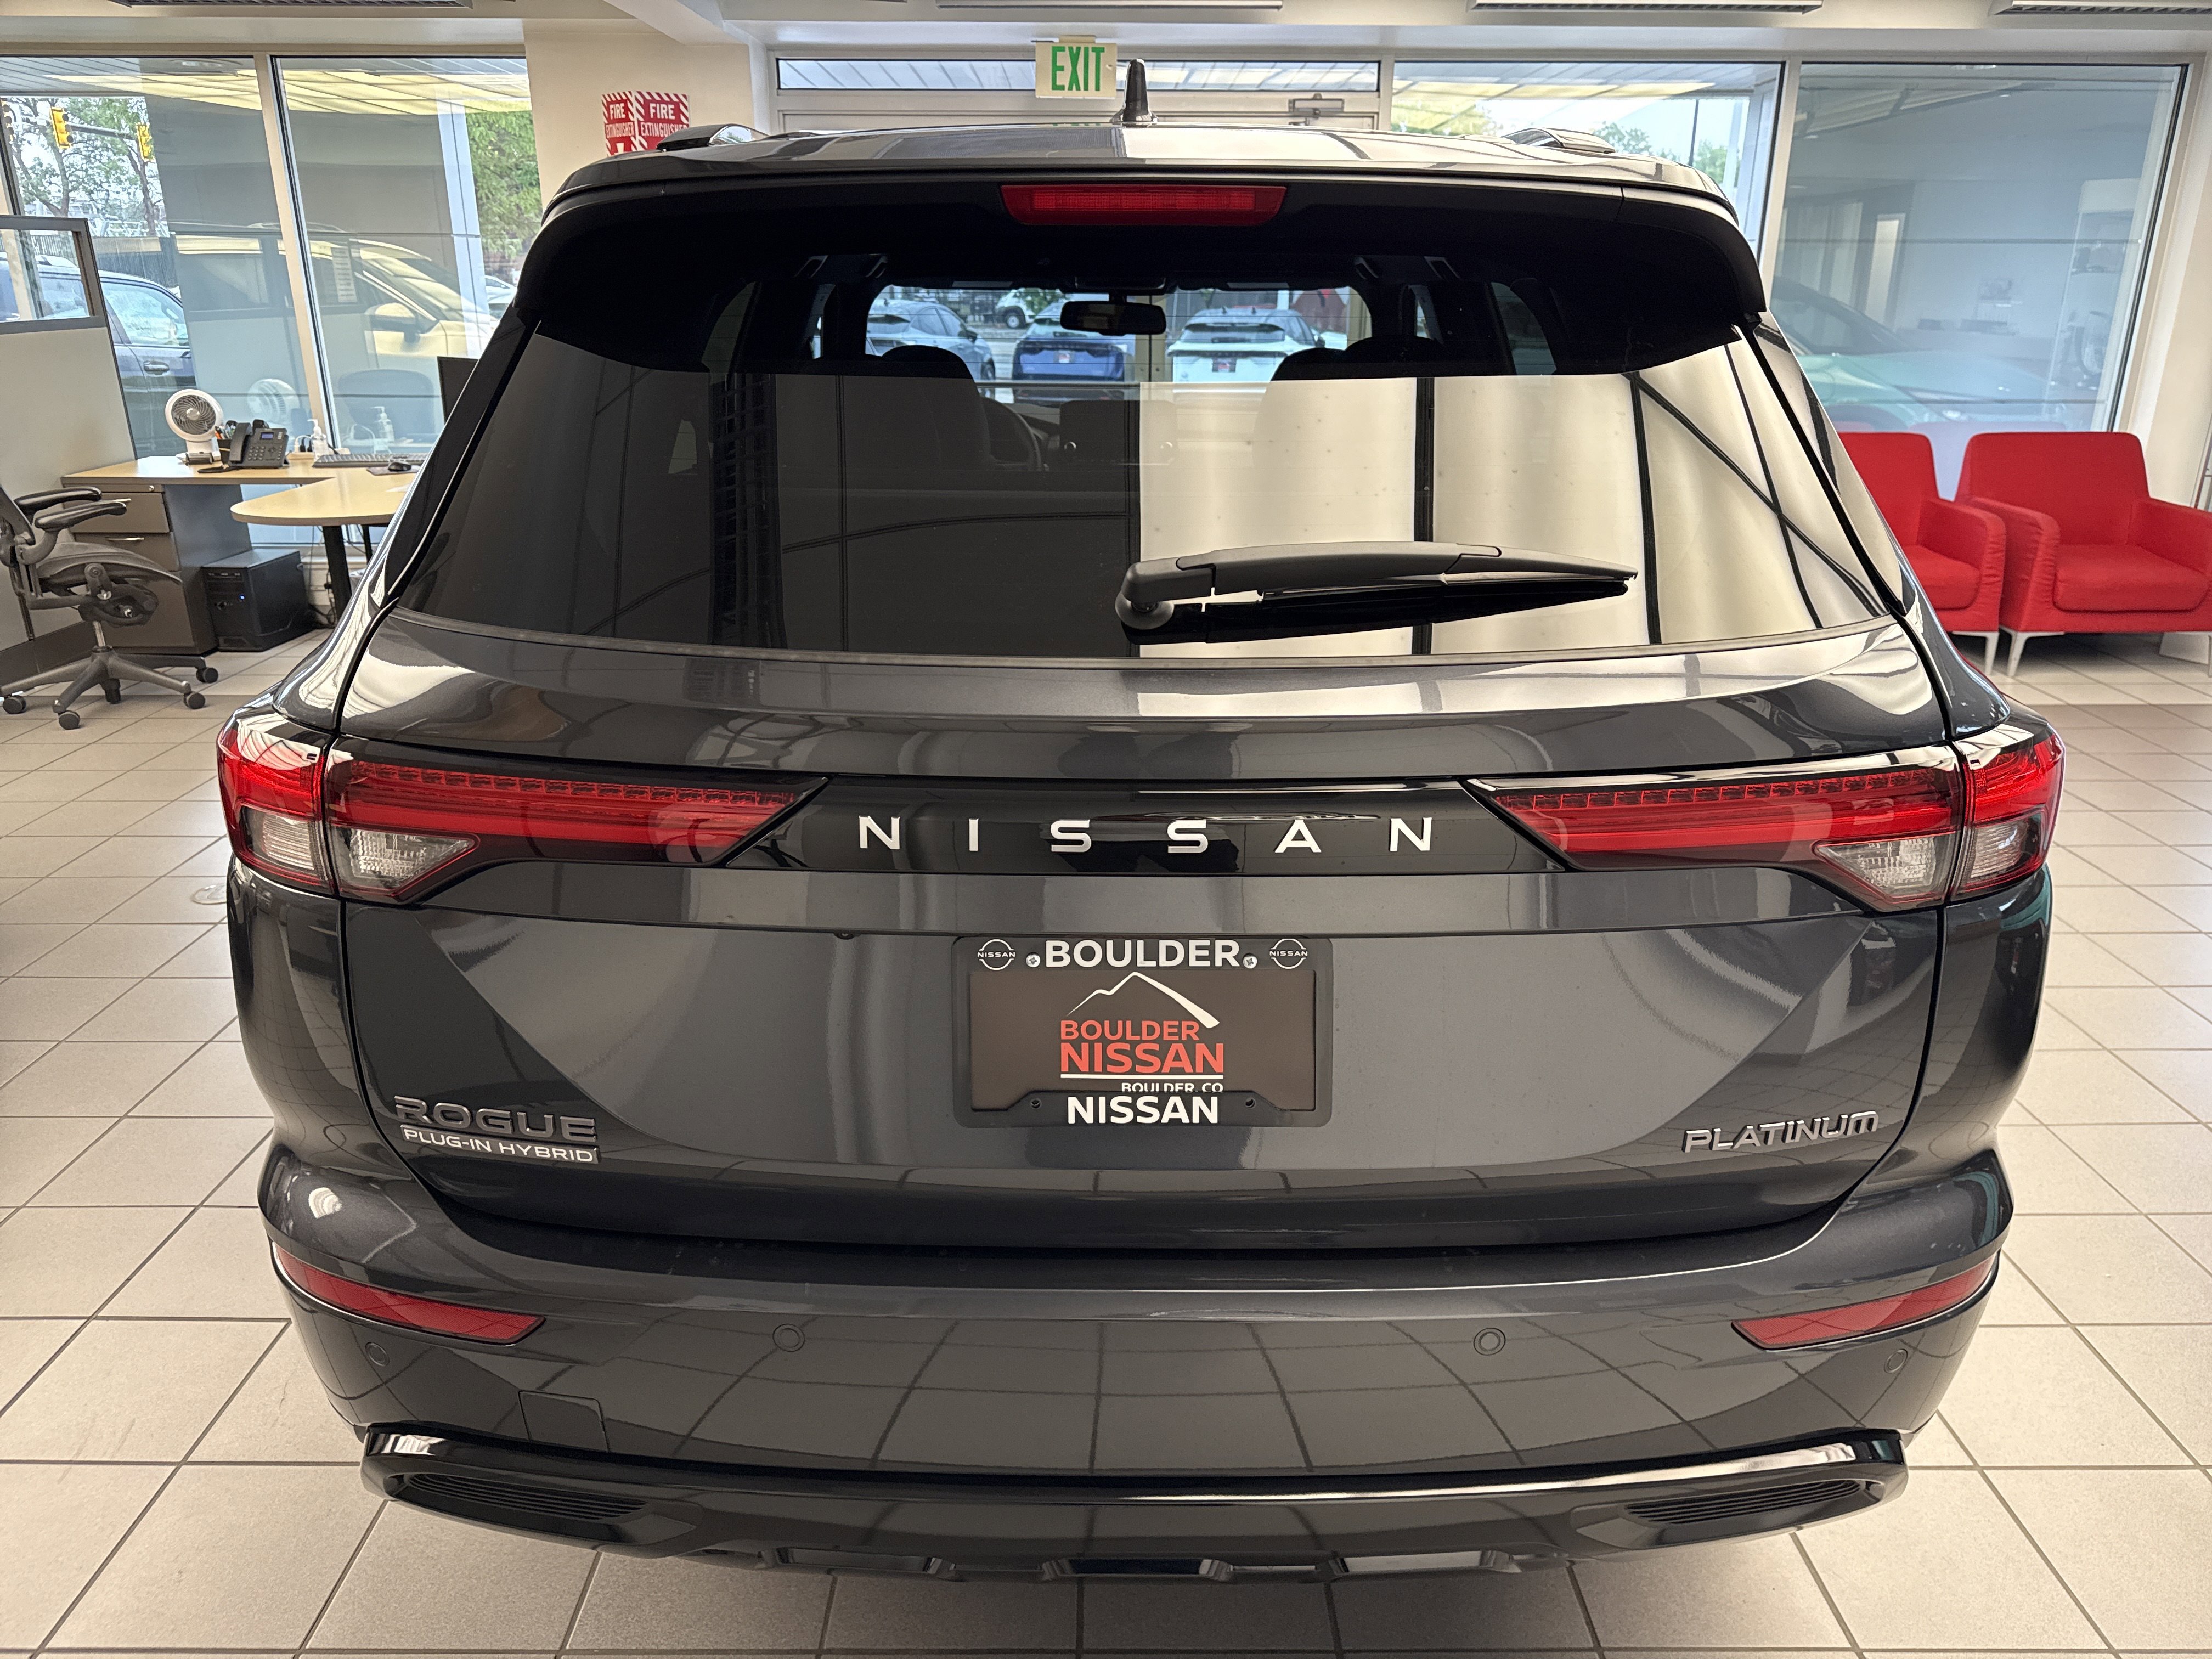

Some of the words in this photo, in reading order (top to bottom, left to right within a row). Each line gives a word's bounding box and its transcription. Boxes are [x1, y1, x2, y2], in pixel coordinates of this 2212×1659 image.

[1051, 46, 1105, 91] EXIT
[610, 103, 625, 120] FIRE
[650, 103, 675, 120] FIRE
[606, 122, 635, 138] EXTINGUISHER
[641, 122, 687, 138] EXTINGUISH
[859, 816, 1432, 853] NISSAN
[1046, 939, 1240, 967] BOULDER
[1060, 1020, 1200, 1041] BOULDER
[1060, 1042, 1224, 1073] NISSAN
[1201, 1082, 1223, 1092] CO
[394, 1096, 597, 1143] ROGUE
[1068, 1096, 1218, 1124] NISSAN
[404, 1128, 492, 1152] PLUG-IN
[499, 1142, 594, 1163] HYBRID
[1682, 1110, 1880, 1153] PLATINUM
